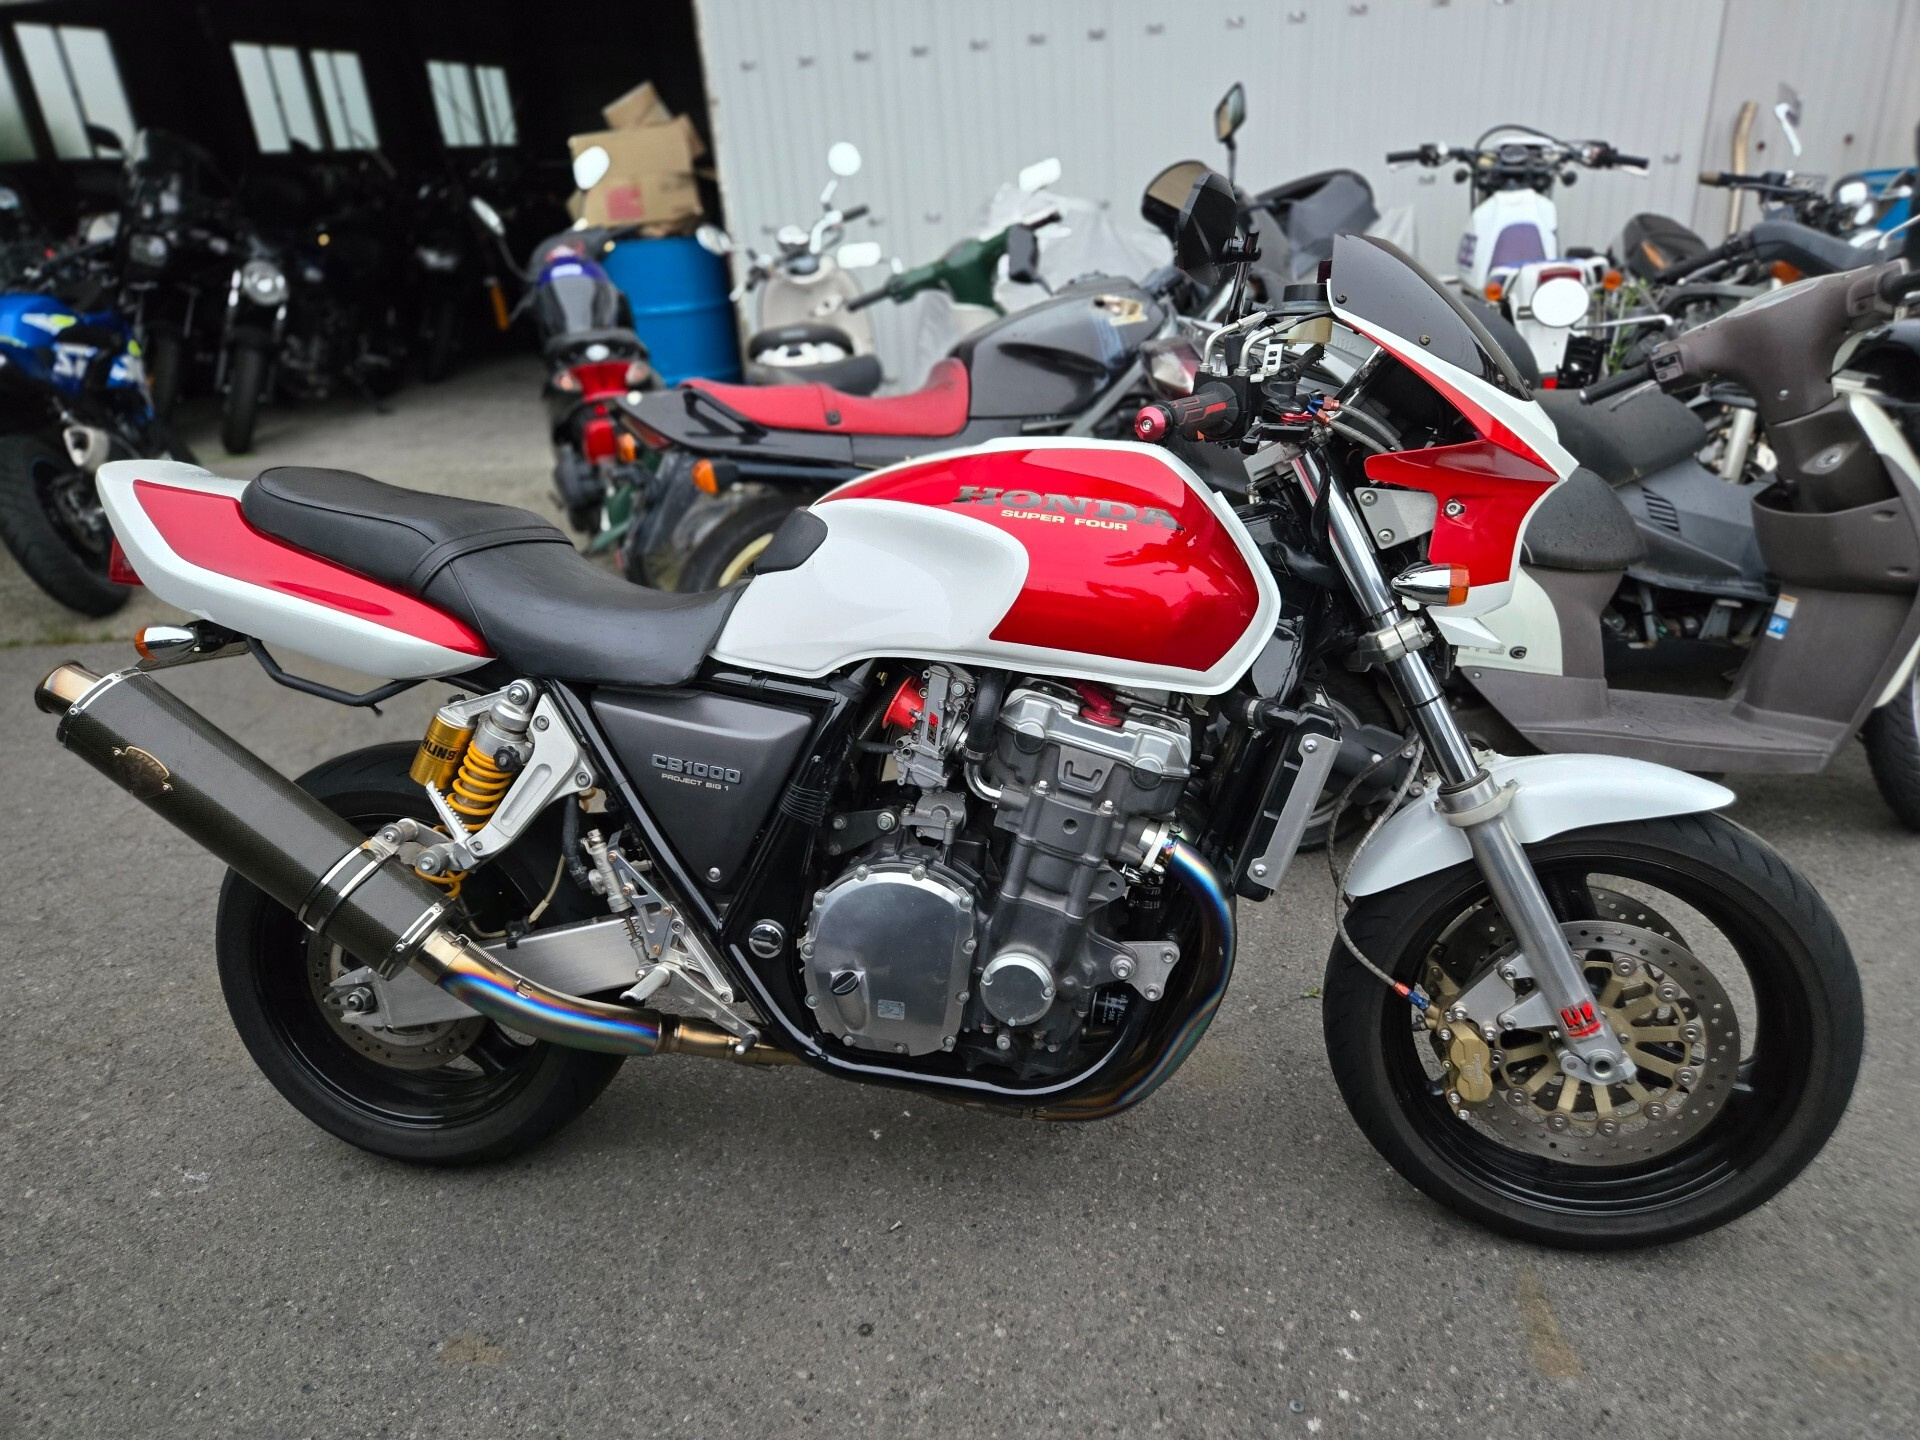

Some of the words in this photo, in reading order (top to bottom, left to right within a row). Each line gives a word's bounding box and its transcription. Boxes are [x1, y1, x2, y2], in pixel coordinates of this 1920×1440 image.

[951, 485, 1184, 531] HONDA
[1001, 509, 1065, 524] SUPER
[1074, 518, 1127, 531] FOUR
[1508, 645, 1527, 660] G
[421, 735, 458, 761] HLINS
[651, 753, 741, 784] CB1000
[661, 773, 703, 787] PROJECT
[705, 782, 722, 790] BIG
